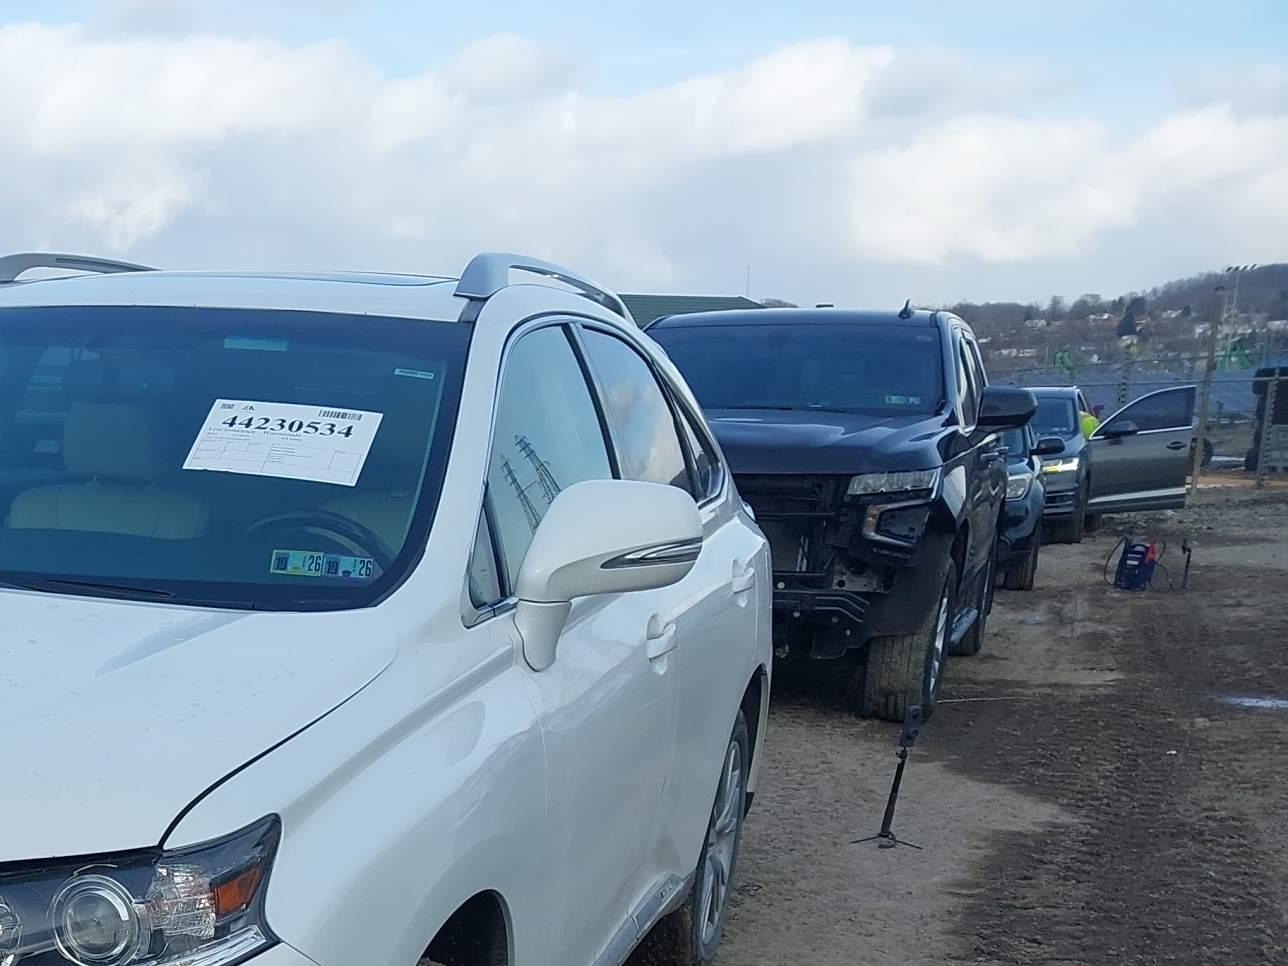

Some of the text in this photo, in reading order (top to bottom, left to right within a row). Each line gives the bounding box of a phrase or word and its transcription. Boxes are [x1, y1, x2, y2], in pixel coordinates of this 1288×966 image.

[222, 415, 354, 438] 44230534
[308, 555, 322, 572] 26
[359, 559, 372, 577] 26
